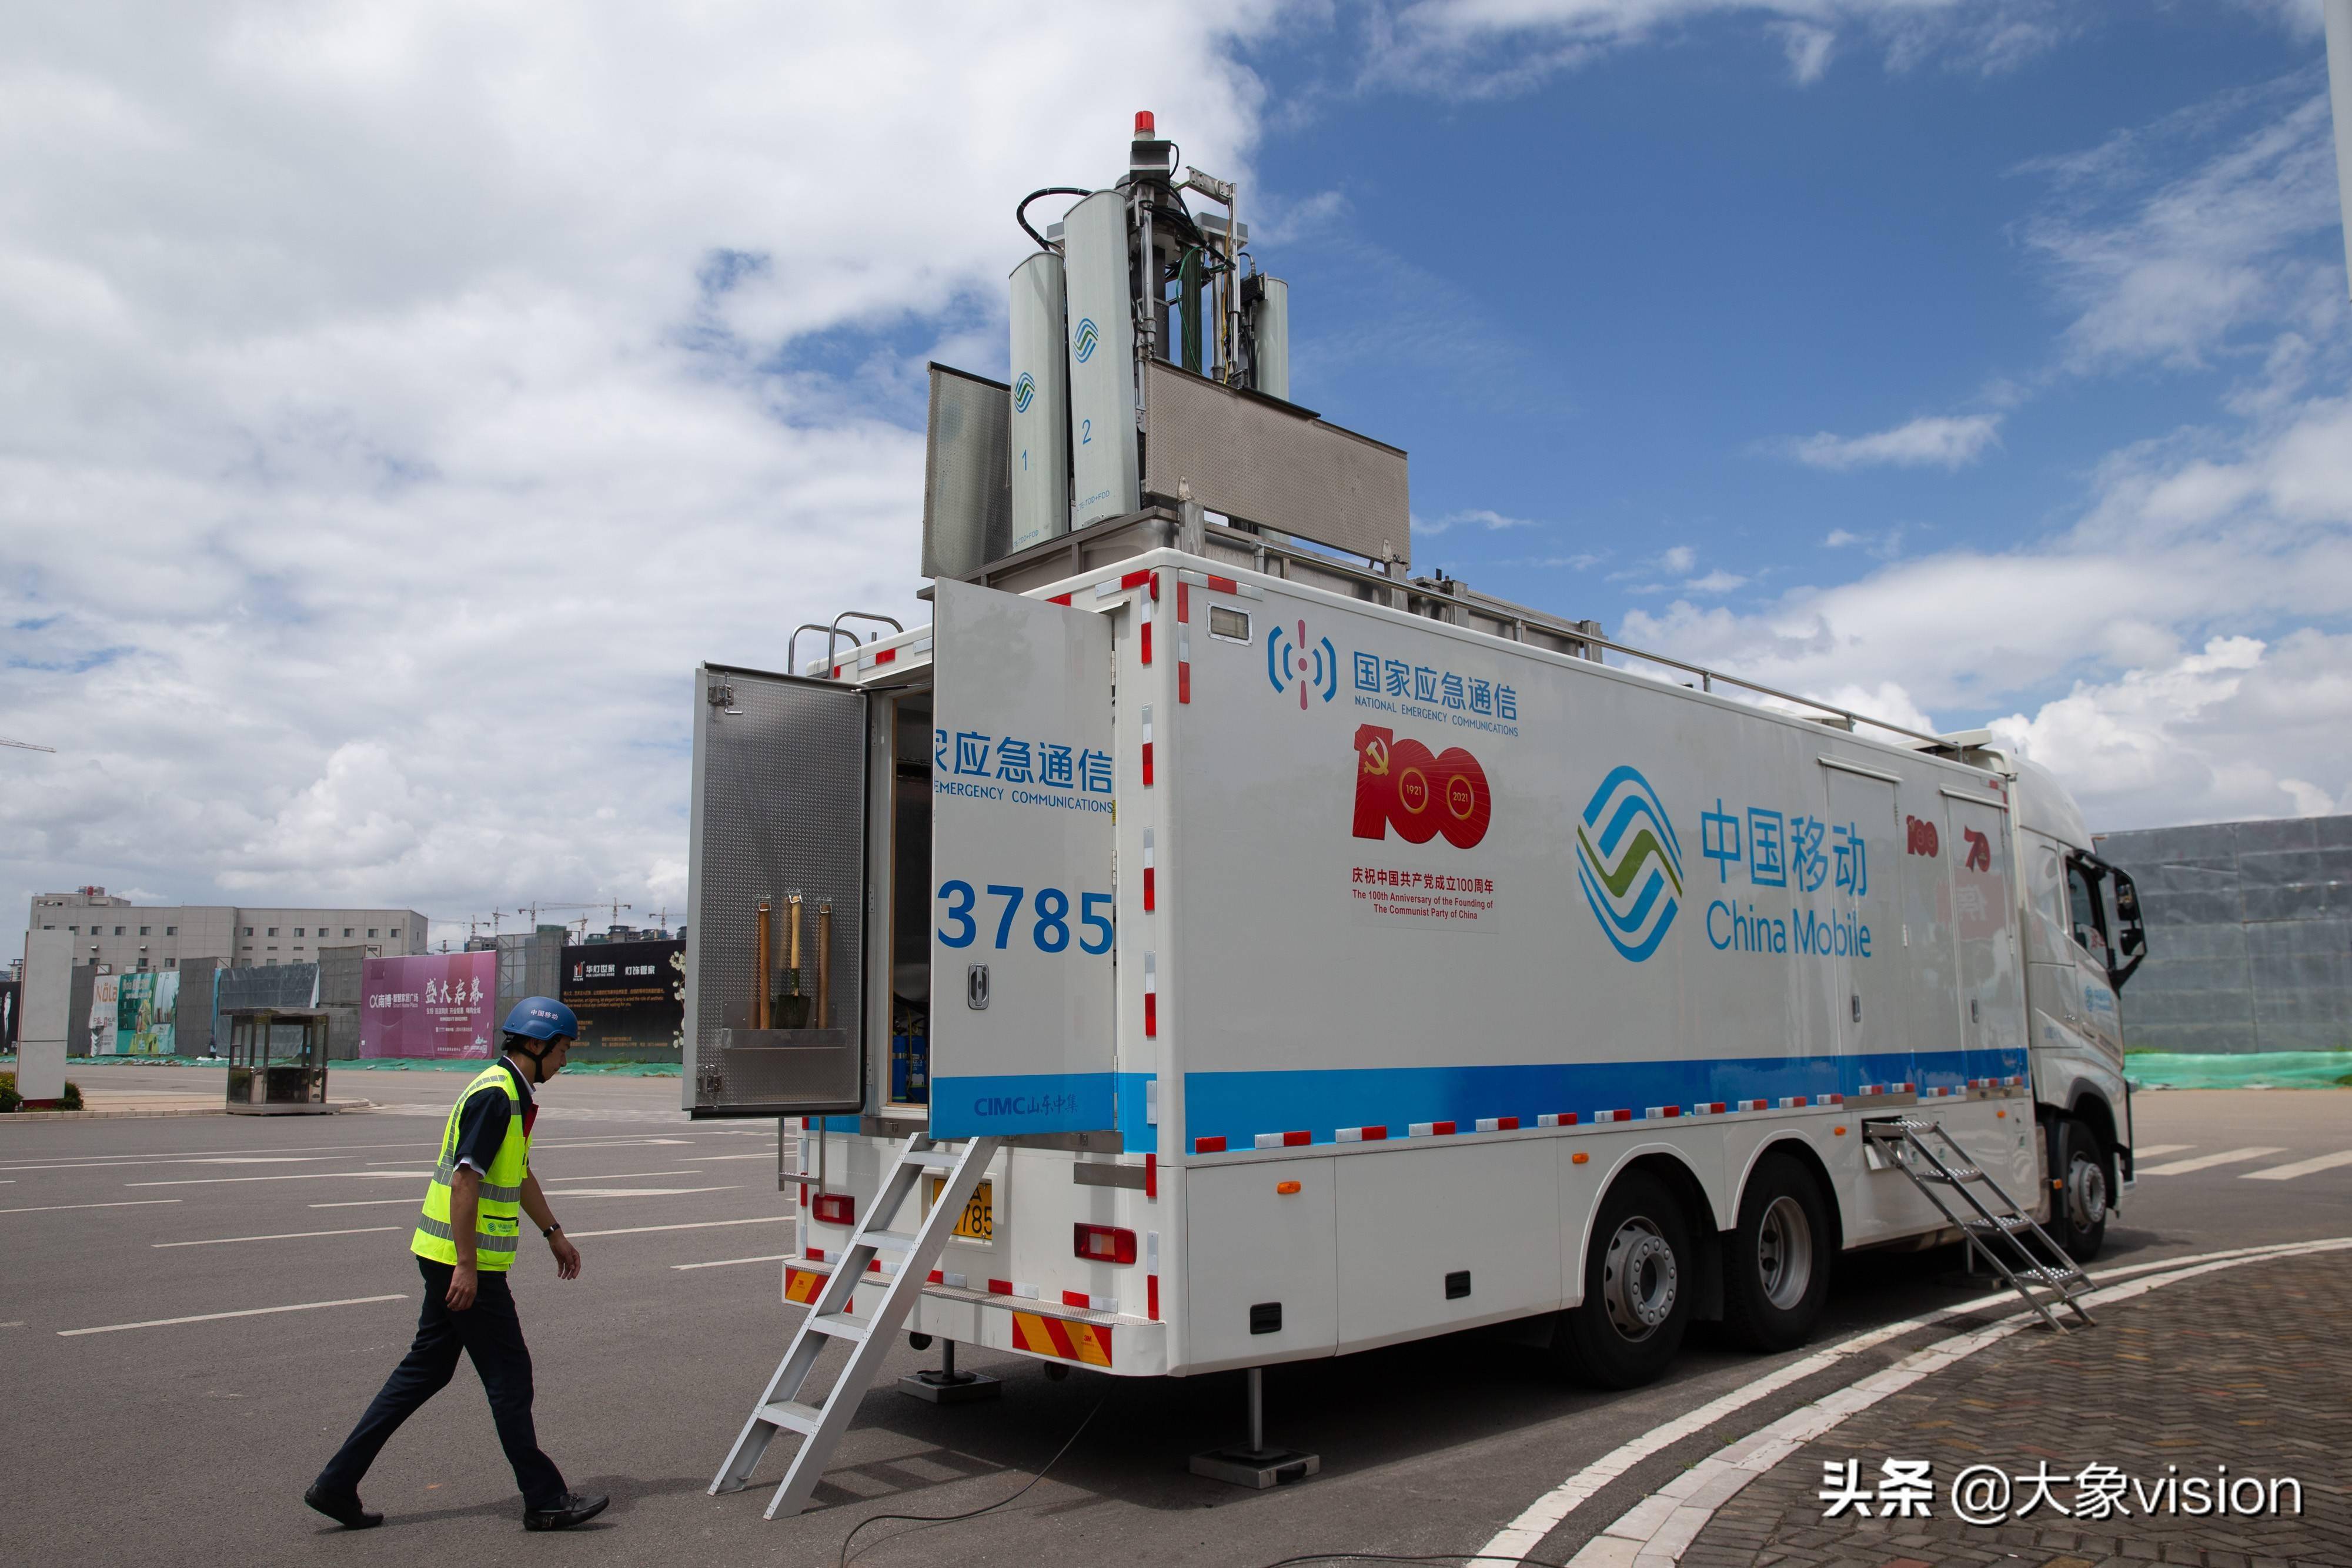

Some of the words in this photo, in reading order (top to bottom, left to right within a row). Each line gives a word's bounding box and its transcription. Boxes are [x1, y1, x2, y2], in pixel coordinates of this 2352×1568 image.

[1081, 419, 1091, 445] 2
[1022, 449, 1027, 471] 1
[1354, 651, 1517, 721] 国家应急通信
[1355, 695, 1398, 713] NATIONAL
[1401, 704, 1448, 723] EMERGENCY
[1452, 714, 1519, 737] COMMUNICATIONS
[934, 780, 1004, 800] EMERGENCY
[1012, 790, 1114, 814] COMMUNICATIONS
[1406, 784, 1422, 796] 1921
[1453, 791, 1468, 803] 2021
[1701, 798, 1867, 897] 中国移动
[1352, 867, 1494, 895] 庆祝中国共产党成立100周年
[1352, 889, 1367, 900] The
[1368, 890, 1388, 901] 100th
[1390, 892, 1432, 906] Anniversary
[1434, 895, 1442, 904] of
[1442, 897, 1453, 906] the
[1455, 897, 1485, 910] Founding
[1486, 900, 1494, 909] of
[1374, 904, 1388, 914] The
[1389, 905, 1429, 917] Communist
[1431, 909, 1448, 920] Party
[1450, 909, 1459, 918] of
[1459, 910, 1478, 920] China
[937, 880, 1114, 955] 3785
[1706, 899, 1787, 954] China
[1793, 908, 1872, 958] Mobile
[586, 964, 615, 974] 华灯世家
[425, 975, 484, 1006] 盛大启幕
[530, 1009, 559, 1020] 中国移动
[974, 1096, 1025, 1116] CIMC
